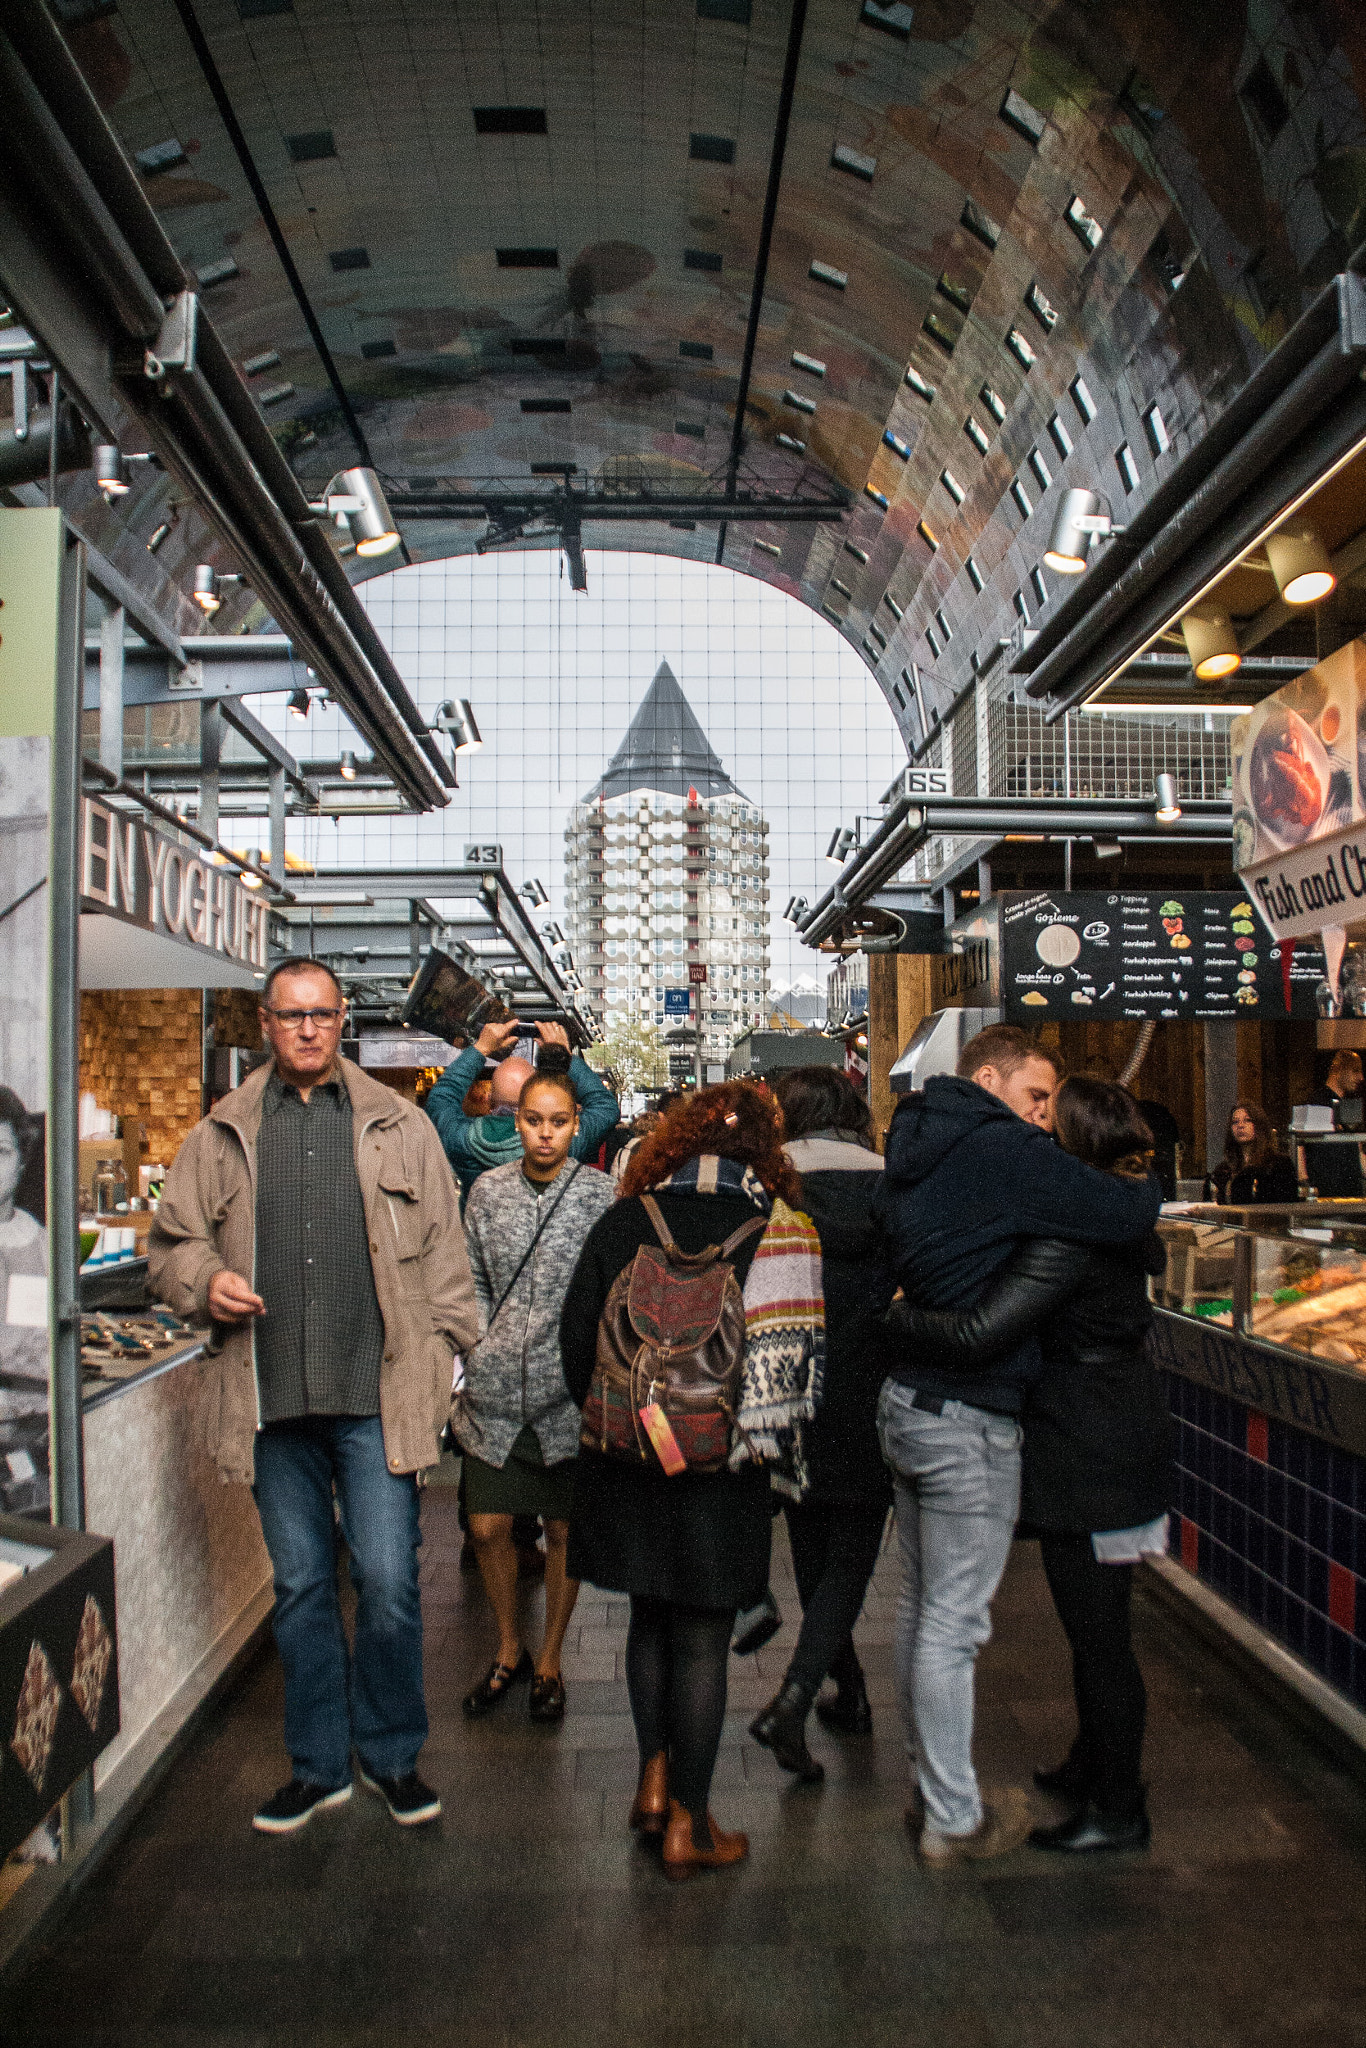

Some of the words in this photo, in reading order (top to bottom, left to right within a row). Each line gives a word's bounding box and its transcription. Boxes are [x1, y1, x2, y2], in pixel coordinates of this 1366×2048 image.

[910, 772, 946, 792] 65
[466, 846, 498, 862] 43
[80, 797, 136, 914] EN
[144, 830, 271, 968] YOGHURT
[1255, 873, 1304, 923] Fish
[1301, 854, 1346, 911] and
